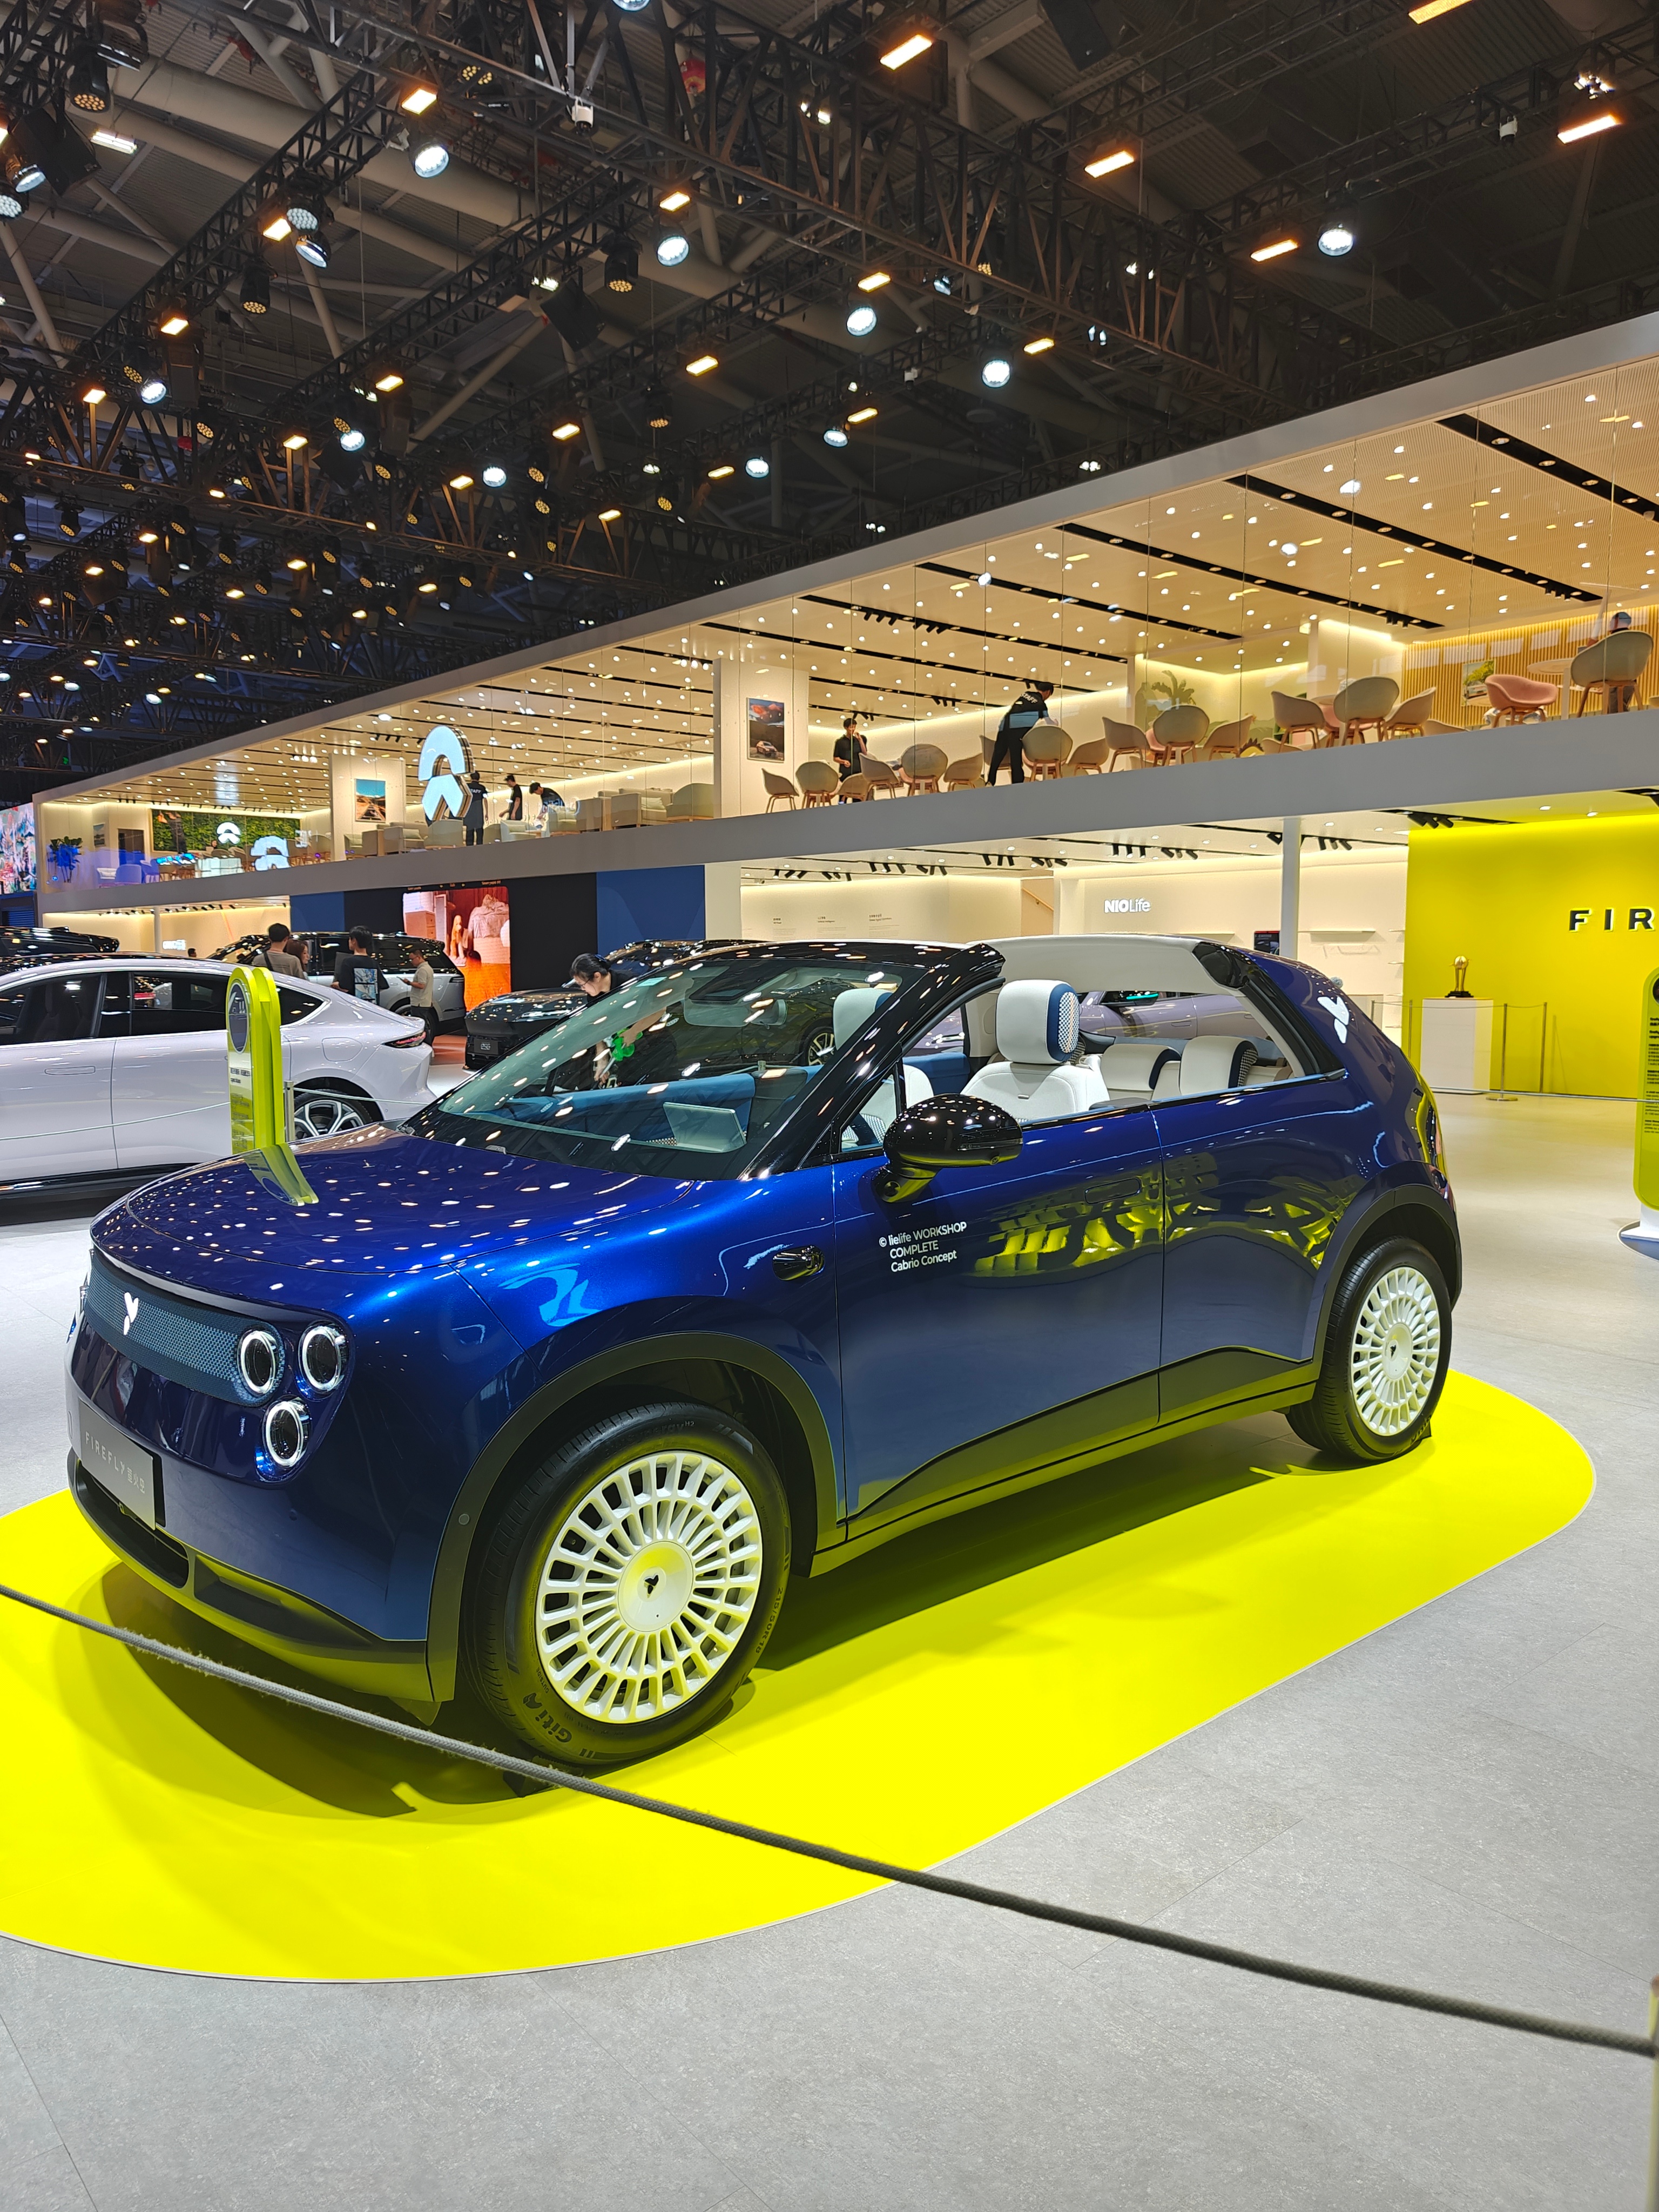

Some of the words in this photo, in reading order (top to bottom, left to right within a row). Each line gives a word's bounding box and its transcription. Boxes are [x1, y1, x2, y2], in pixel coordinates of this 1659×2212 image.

[1021, 692, 1038, 704] STAFF
[1569, 908, 1654, 932] FIR
[913, 1221, 967, 1240] WORKSHOP
[889, 1240, 939, 1259] COMPLETE
[891, 1257, 920, 1272] Cabrio
[921, 1250, 957, 1266] Concept
[85, 1431, 125, 1475] FIREFLY
[127, 1467, 146, 1494] 萤火虫
[756, 1587, 783, 1654] 215/50R18
[536, 1667, 549, 1694] OUTSIDE
[535, 1709, 572, 1743] Giti
